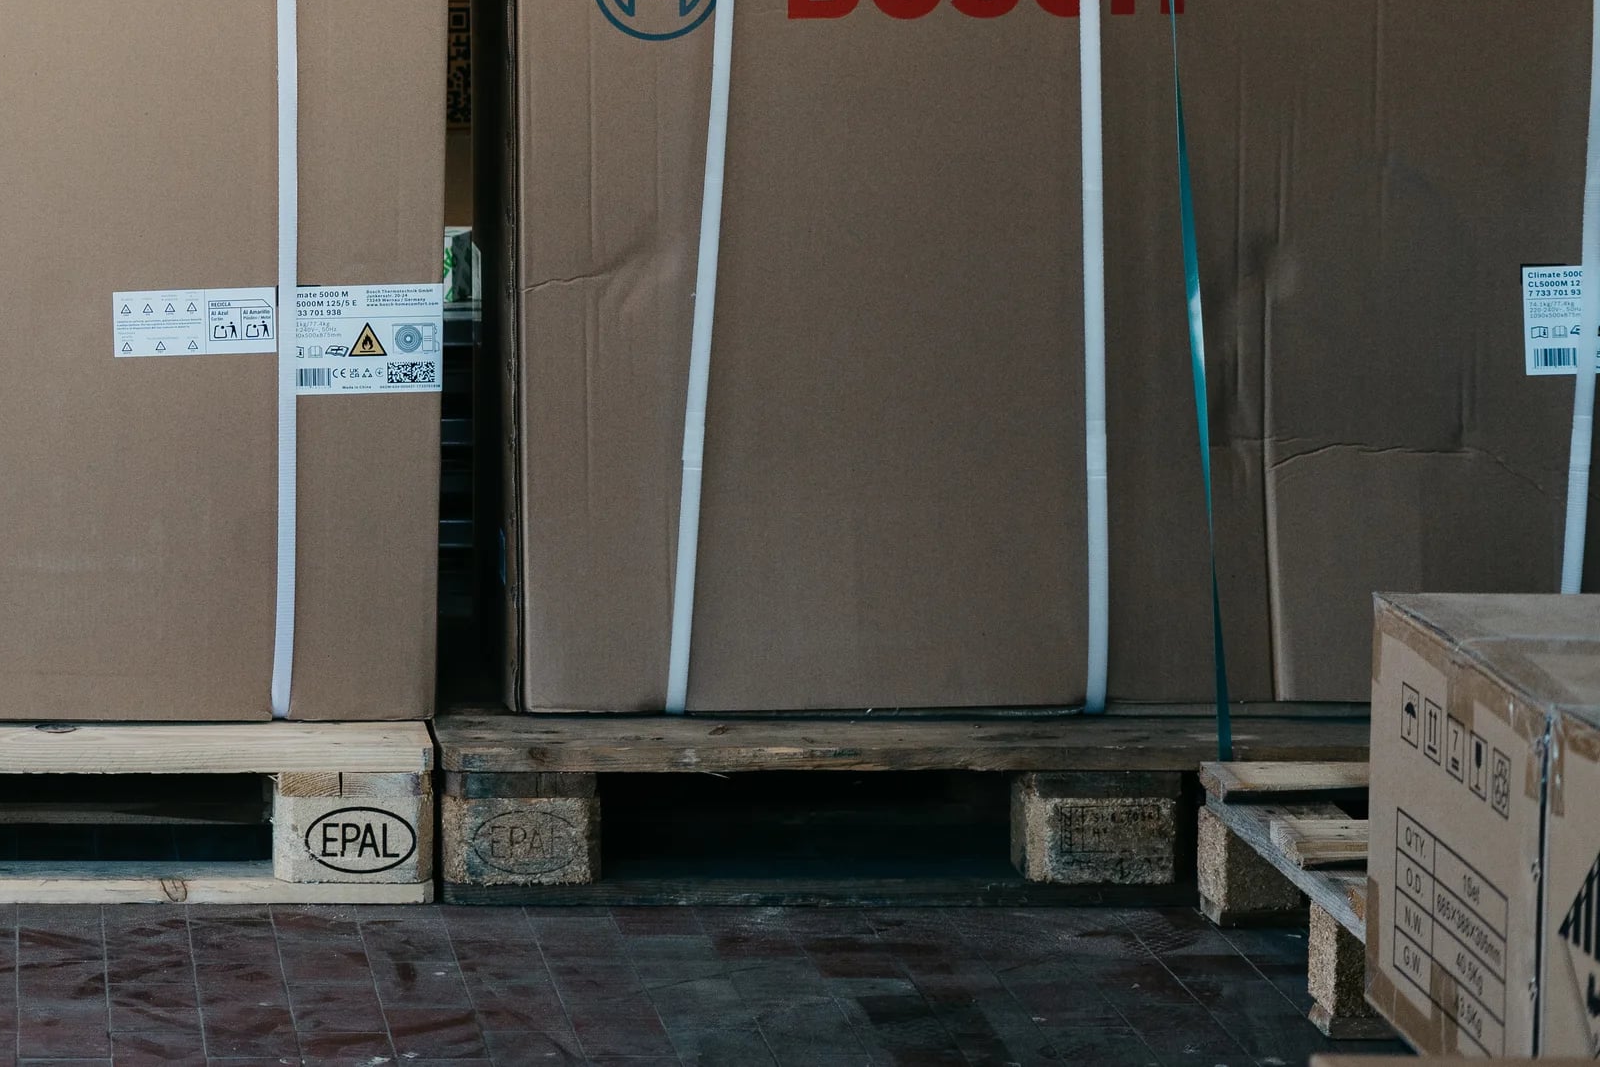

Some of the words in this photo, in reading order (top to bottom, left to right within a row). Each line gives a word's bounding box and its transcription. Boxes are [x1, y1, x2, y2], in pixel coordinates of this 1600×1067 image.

[332, 368, 346, 378] CE
[321, 823, 399, 858] EPAL
[1406, 867, 1423, 898] O.D.
[1405, 906, 1423, 937] N.W.
[1404, 945, 1422, 978] G.W.
